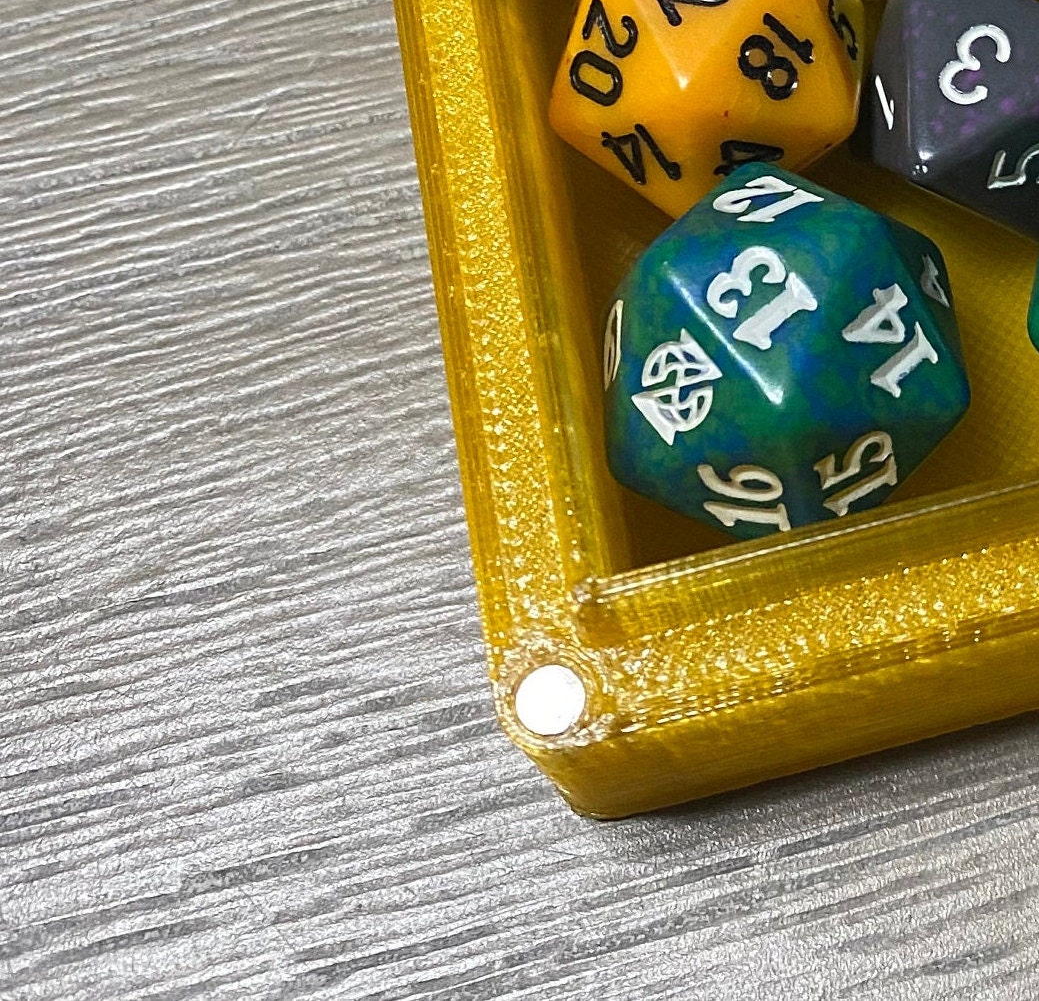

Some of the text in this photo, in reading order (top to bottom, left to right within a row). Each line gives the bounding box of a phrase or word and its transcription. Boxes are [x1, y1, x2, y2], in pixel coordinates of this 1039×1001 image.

[737, 12, 815, 101] 18
[938, 23, 1011, 105] 3
[601, 123, 682, 186] 14
[712, 175, 825, 223] 12
[706, 245, 818, 350] 13
[841, 283, 939, 399] 14
[697, 464, 791, 531] 16
[812, 430, 898, 517] 15
